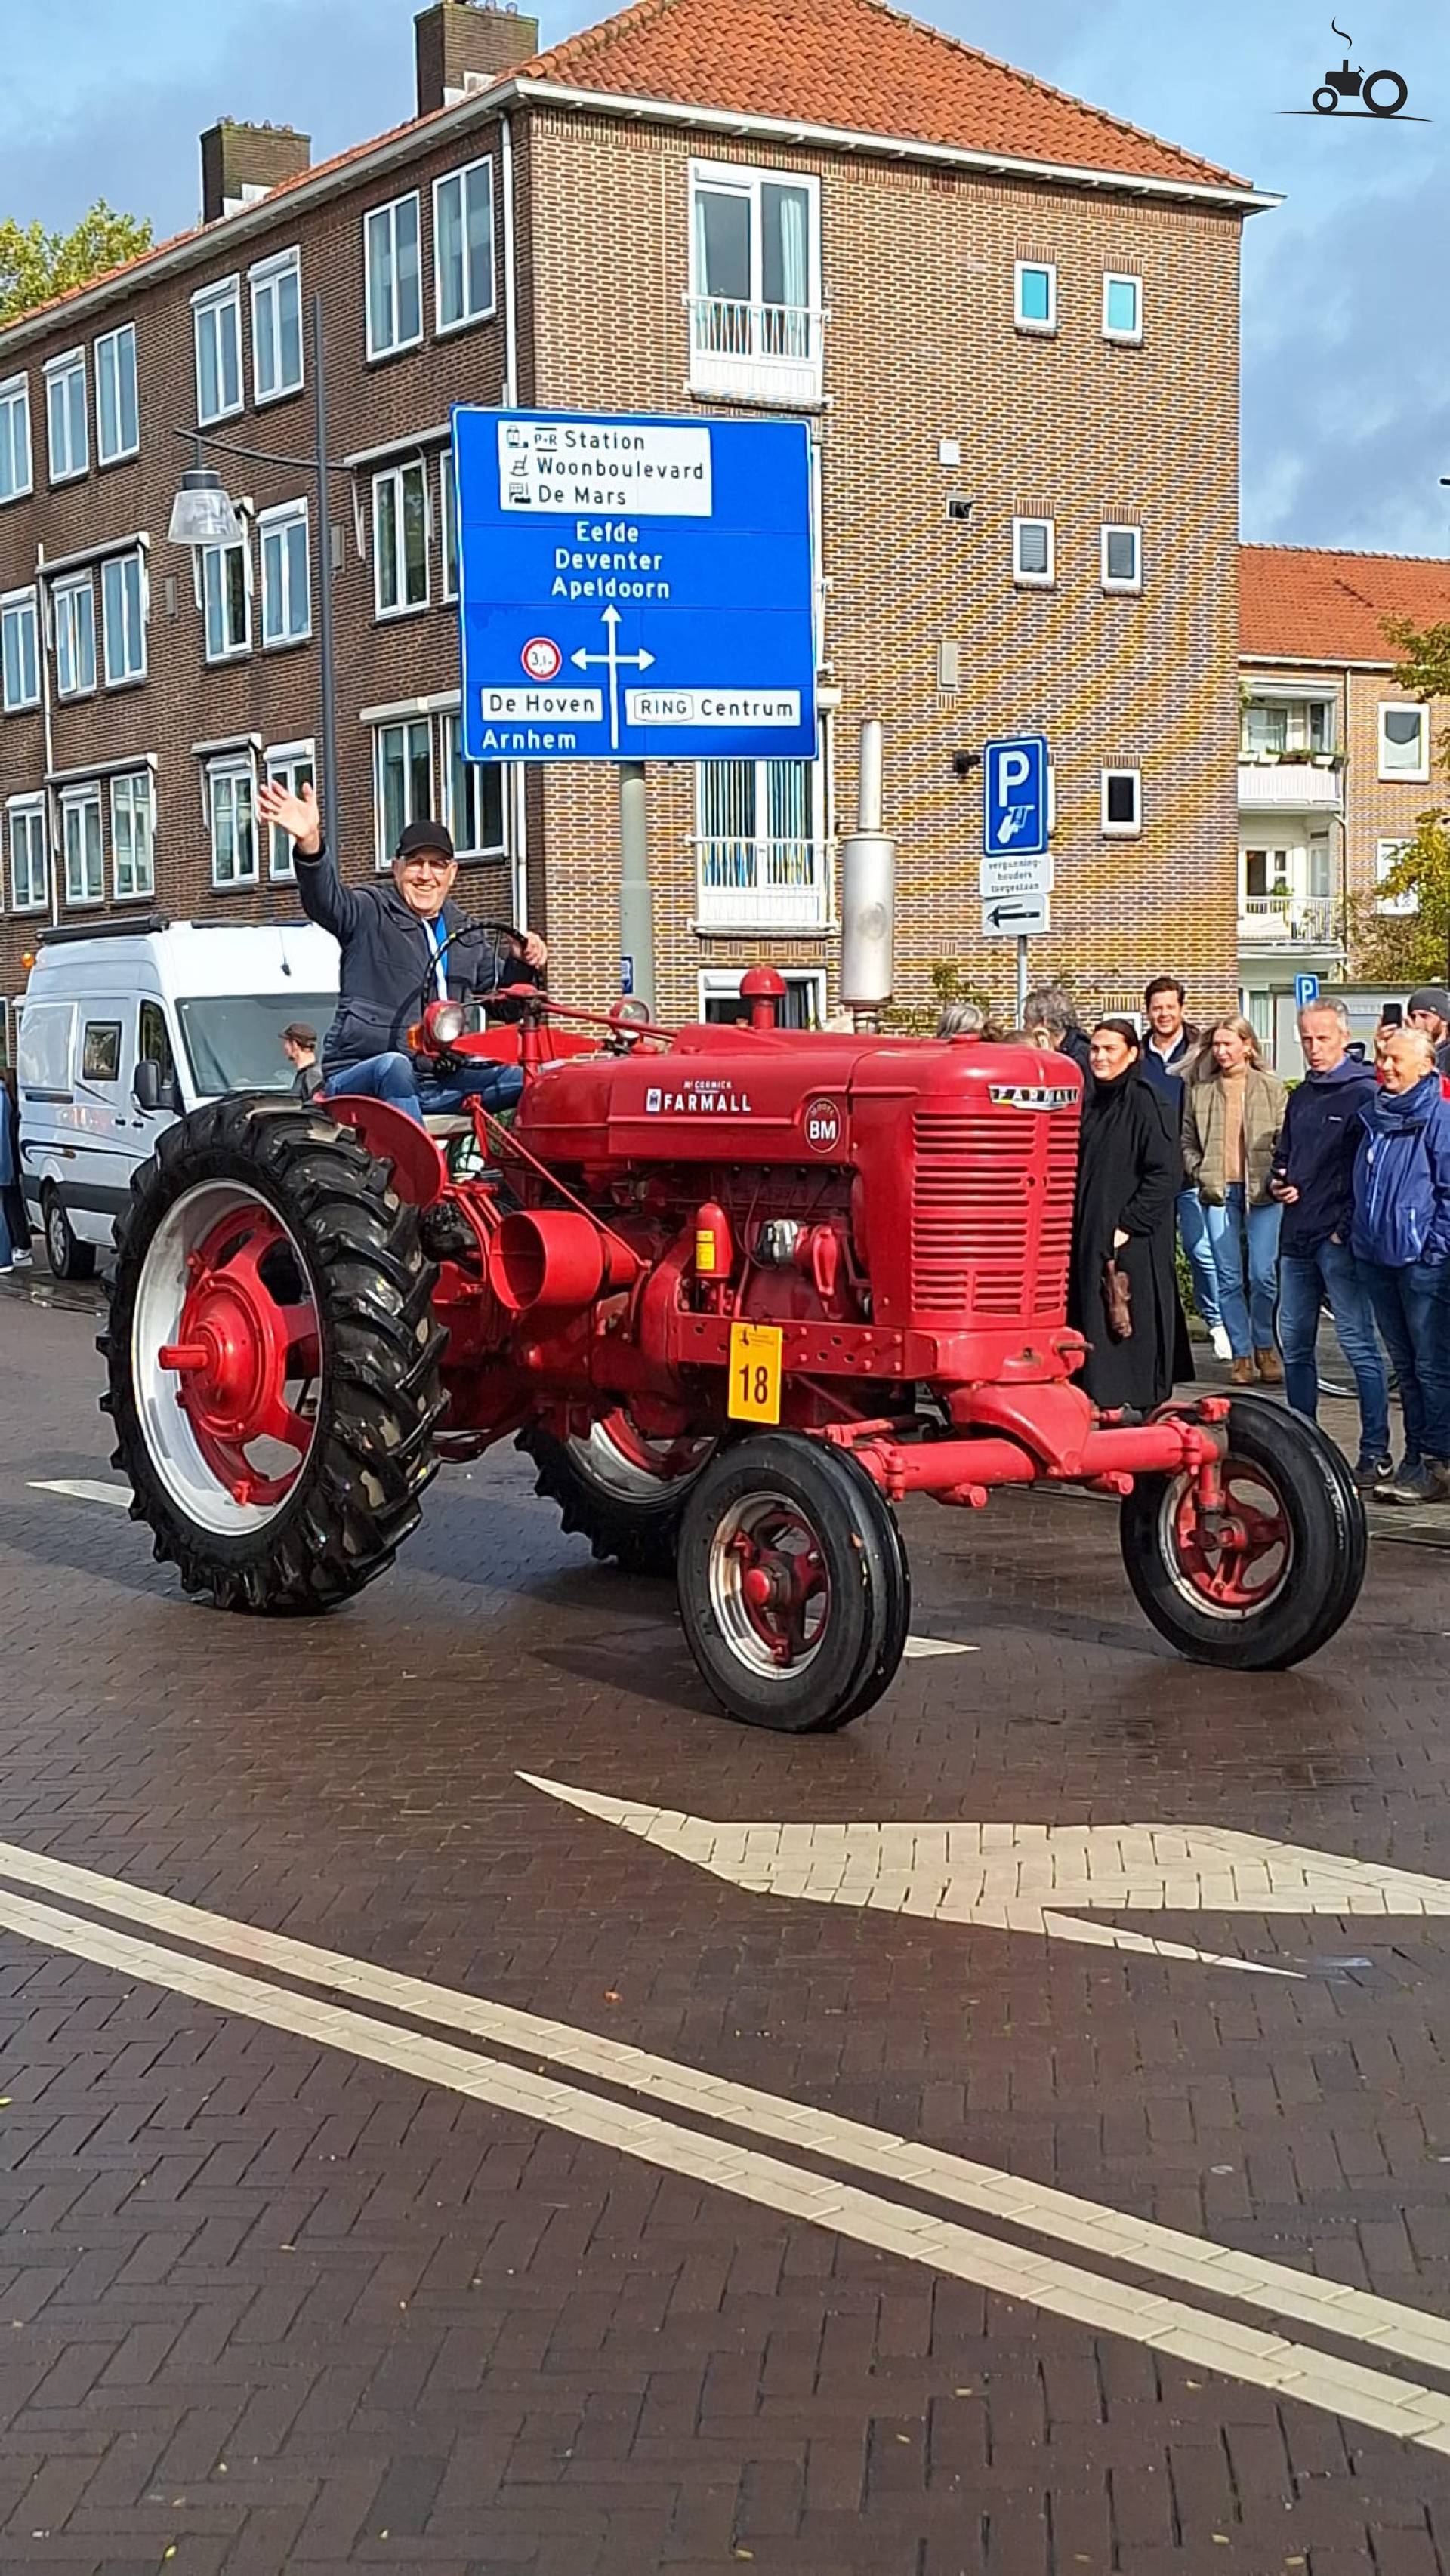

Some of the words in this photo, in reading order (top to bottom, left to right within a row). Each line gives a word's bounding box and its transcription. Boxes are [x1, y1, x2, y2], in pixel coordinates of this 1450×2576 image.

[565, 430, 645, 451] Station
[536, 457, 704, 479] Woonboulevard
[538, 485, 564, 503] De
[575, 486, 626, 505] Mars
[576, 521, 639, 543] Eefde
[555, 548, 662, 571] Deventer
[551, 575, 670, 601] Apeldoorn
[489, 694, 517, 712] De
[526, 694, 594, 713] Hoven
[641, 699, 687, 715] RING
[701, 699, 793, 716] Centrum
[482, 729, 576, 750] Arnhem
[998, 750, 1030, 808] P
[1302, 980, 1313, 1003] P
[664, 1093, 751, 1112] FARMALL
[809, 1120, 836, 1140] BM
[739, 1363, 768, 1404] 18
